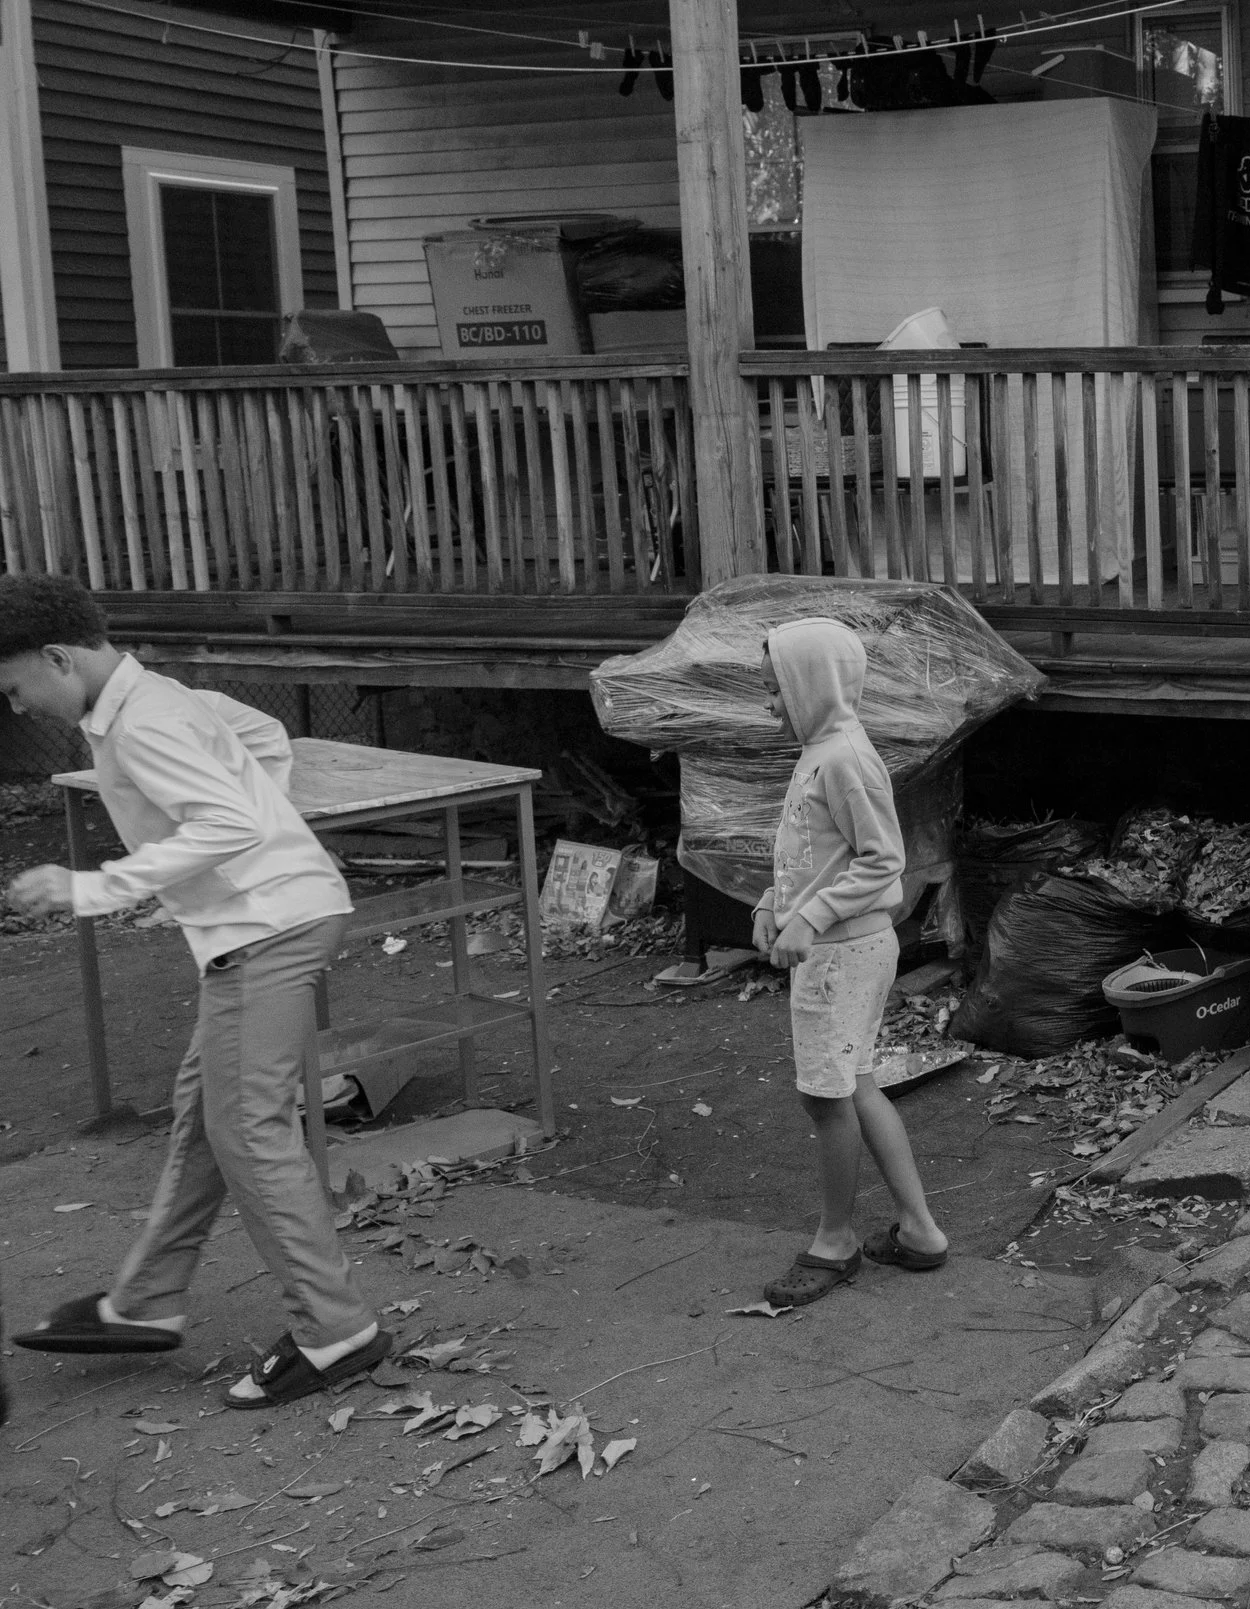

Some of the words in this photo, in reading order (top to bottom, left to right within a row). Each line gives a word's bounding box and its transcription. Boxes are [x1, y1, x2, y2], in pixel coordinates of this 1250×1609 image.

[463, 305, 489, 316] CHEST
[492, 304, 532, 314] FREEZER
[460, 325, 541, 343] BC/BD-110
[1196, 996, 1240, 1019] O-Cedar
